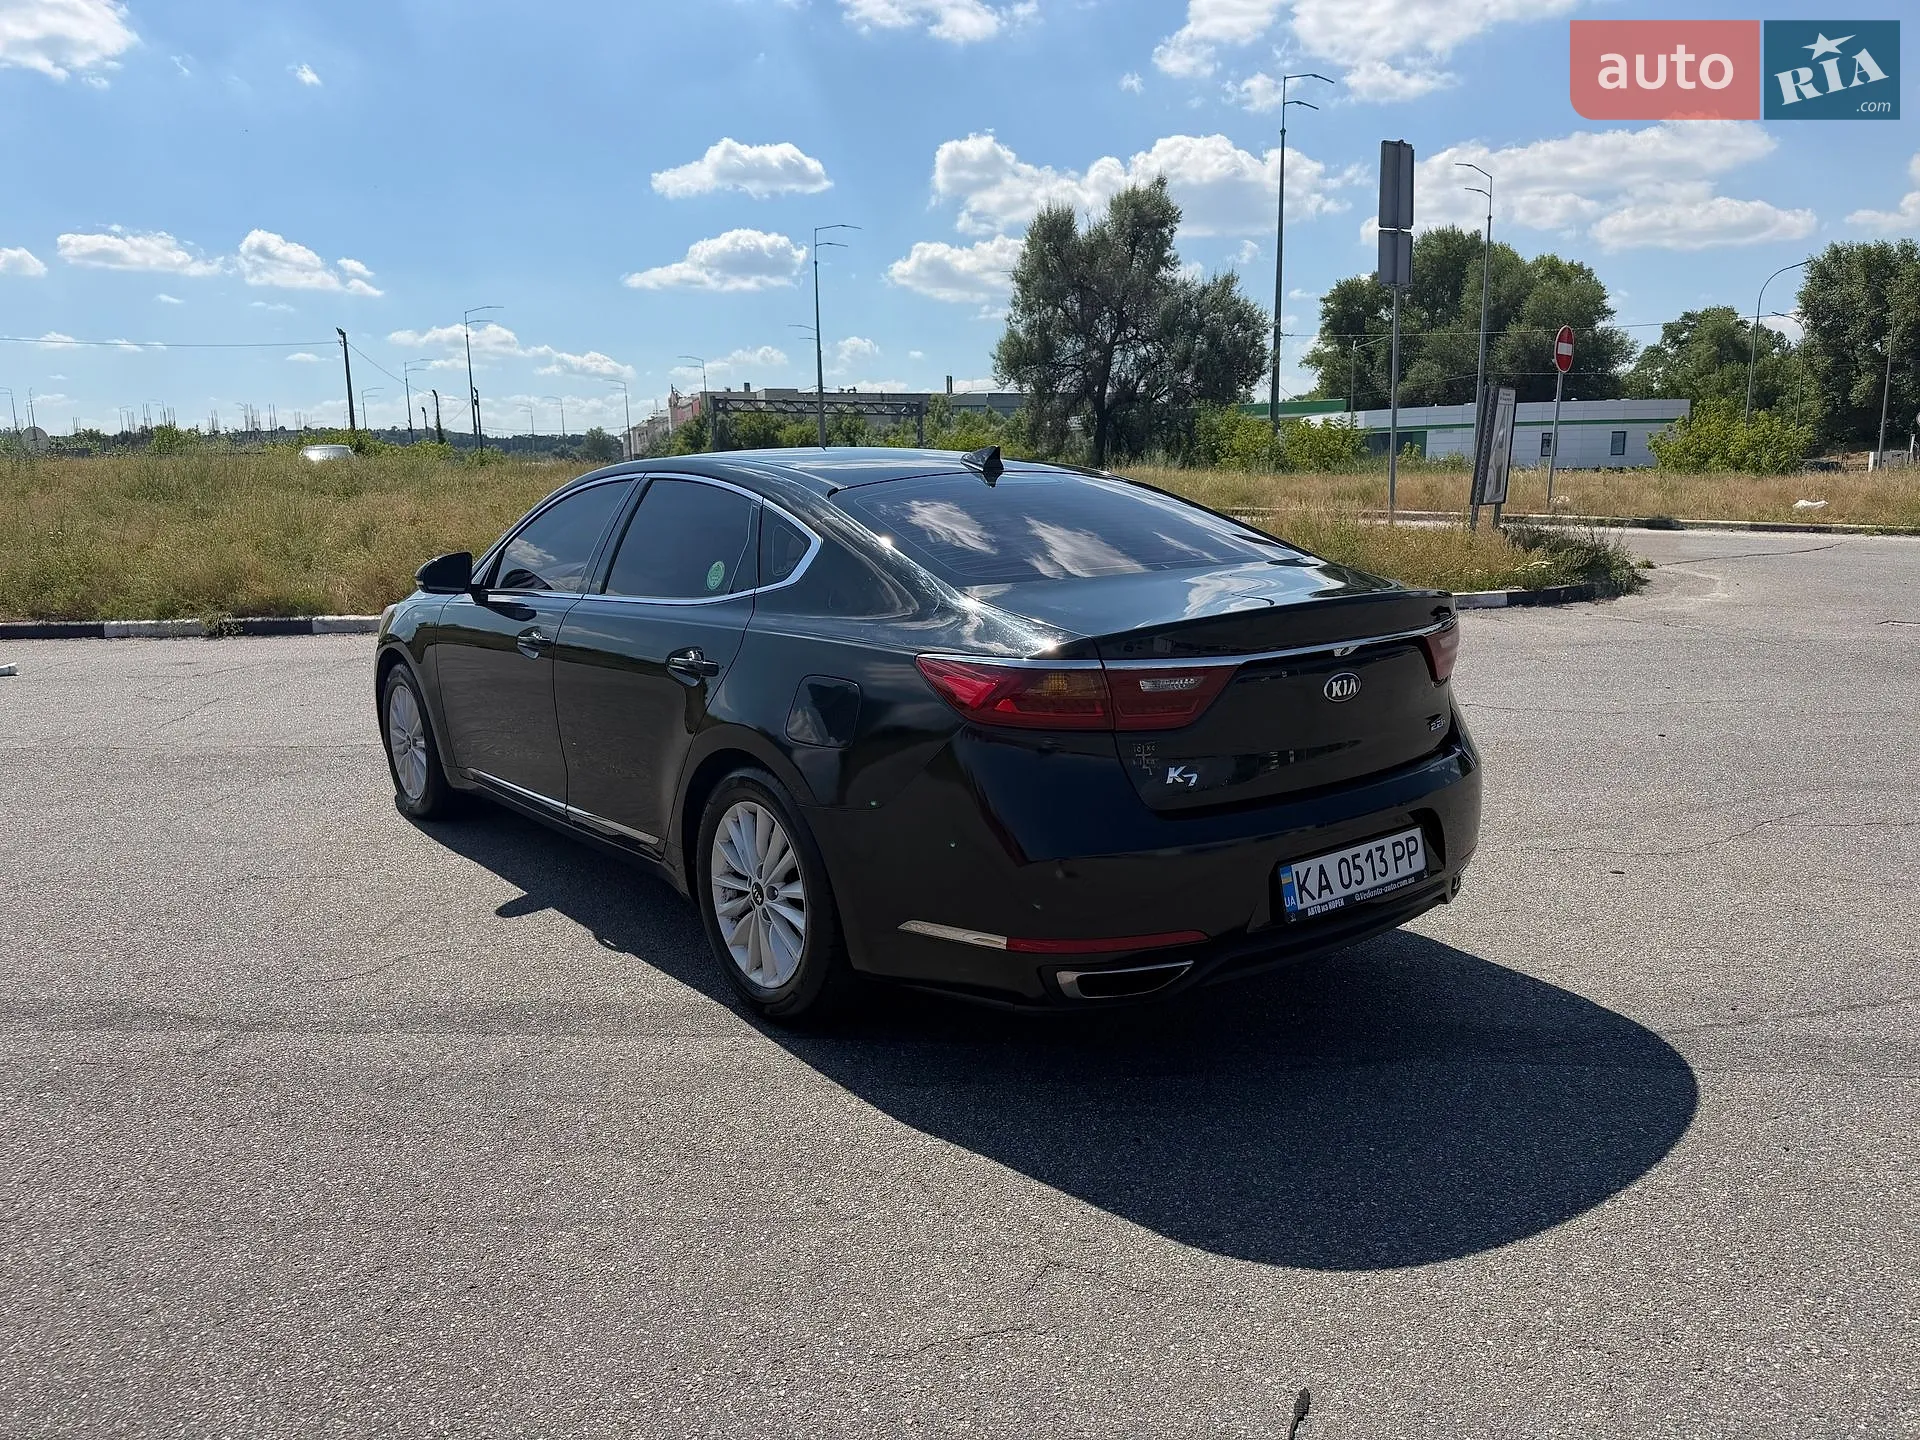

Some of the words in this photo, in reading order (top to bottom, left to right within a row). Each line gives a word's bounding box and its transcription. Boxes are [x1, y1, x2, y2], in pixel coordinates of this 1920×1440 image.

[1331, 678, 1357, 698] KIA
[1165, 765, 1198, 787] K7
[1294, 864, 1334, 905] KA
[1337, 844, 1389, 890] 0513
[1391, 835, 1419, 874] PP
[1284, 895, 1297, 908] UA
